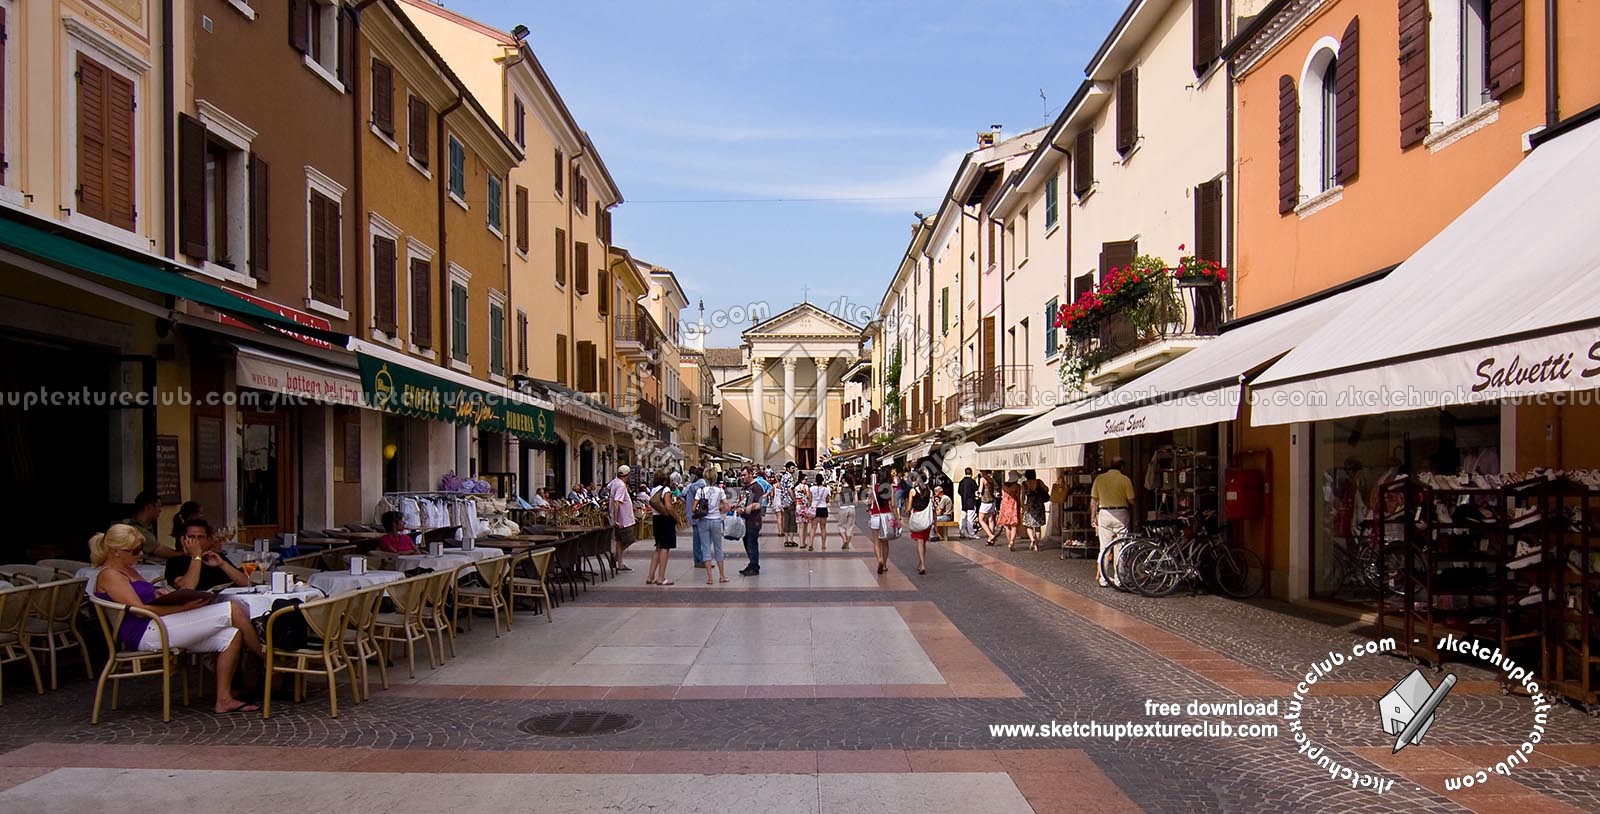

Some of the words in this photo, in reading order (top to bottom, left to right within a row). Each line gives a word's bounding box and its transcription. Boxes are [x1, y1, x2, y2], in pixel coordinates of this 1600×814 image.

[252, 373, 267, 386] WINE
[268, 377, 279, 388] BAR
[1472, 352, 1574, 392] Salvetti
[286, 372, 320, 398] bottega
[324, 381, 337, 398] del
[506, 410, 534, 433] BIRRERIA
[1127, 414, 1146, 432] Sport
